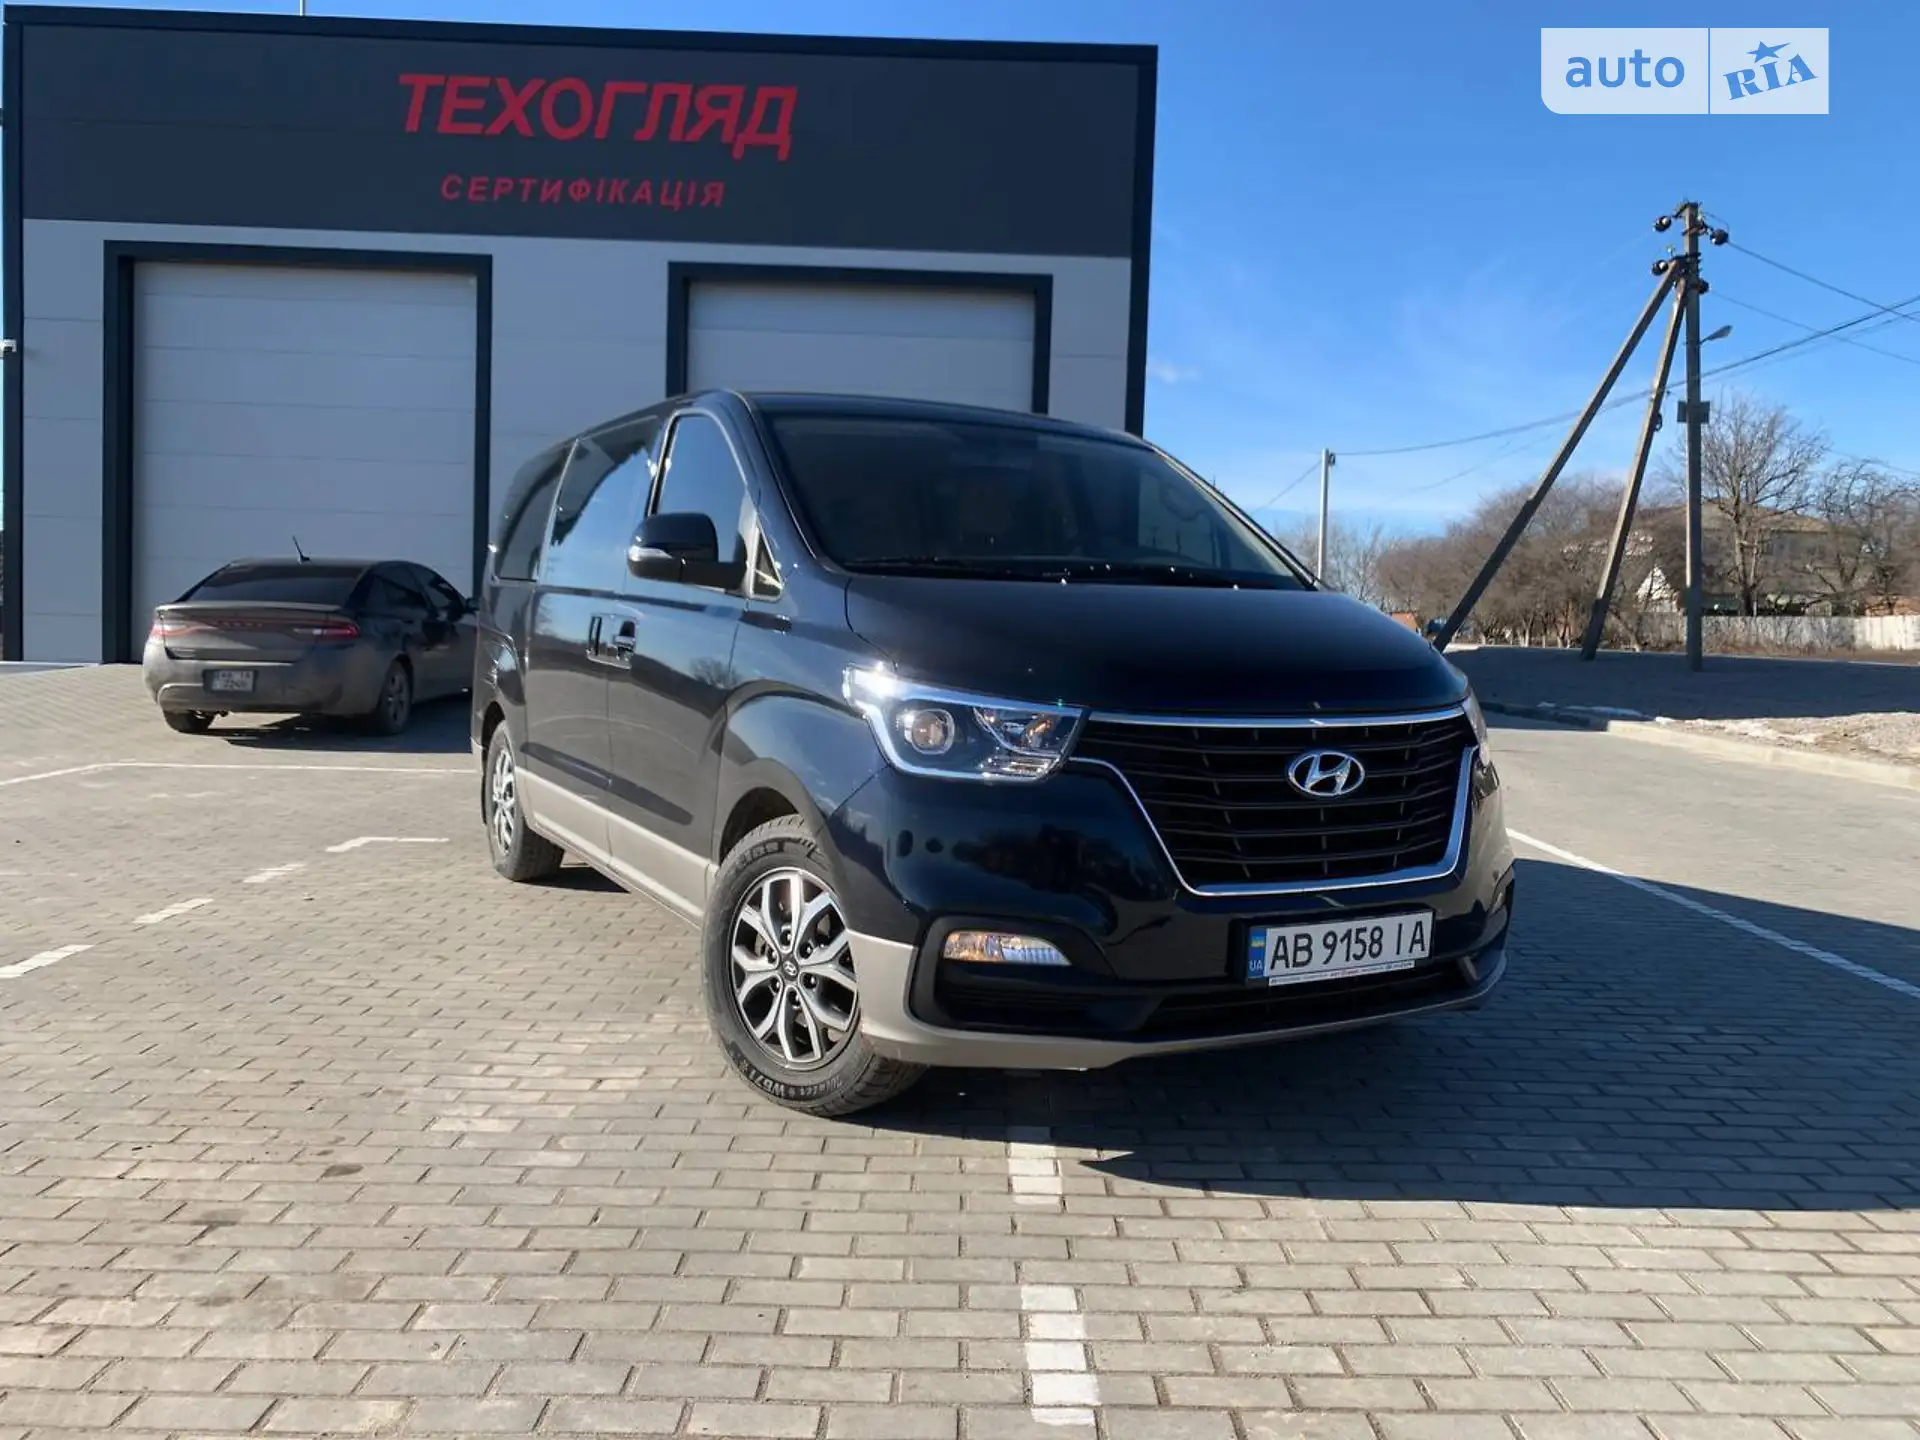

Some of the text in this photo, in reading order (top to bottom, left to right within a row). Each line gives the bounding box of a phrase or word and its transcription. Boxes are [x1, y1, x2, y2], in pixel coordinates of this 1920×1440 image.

[398, 74, 797, 160] ТЕХОГЛЯД
[440, 175, 726, 211] СЕРТИФІКАЦІЯ
[1249, 960, 1263, 971] UA
[1270, 921, 1425, 970] AB 9158 IA
